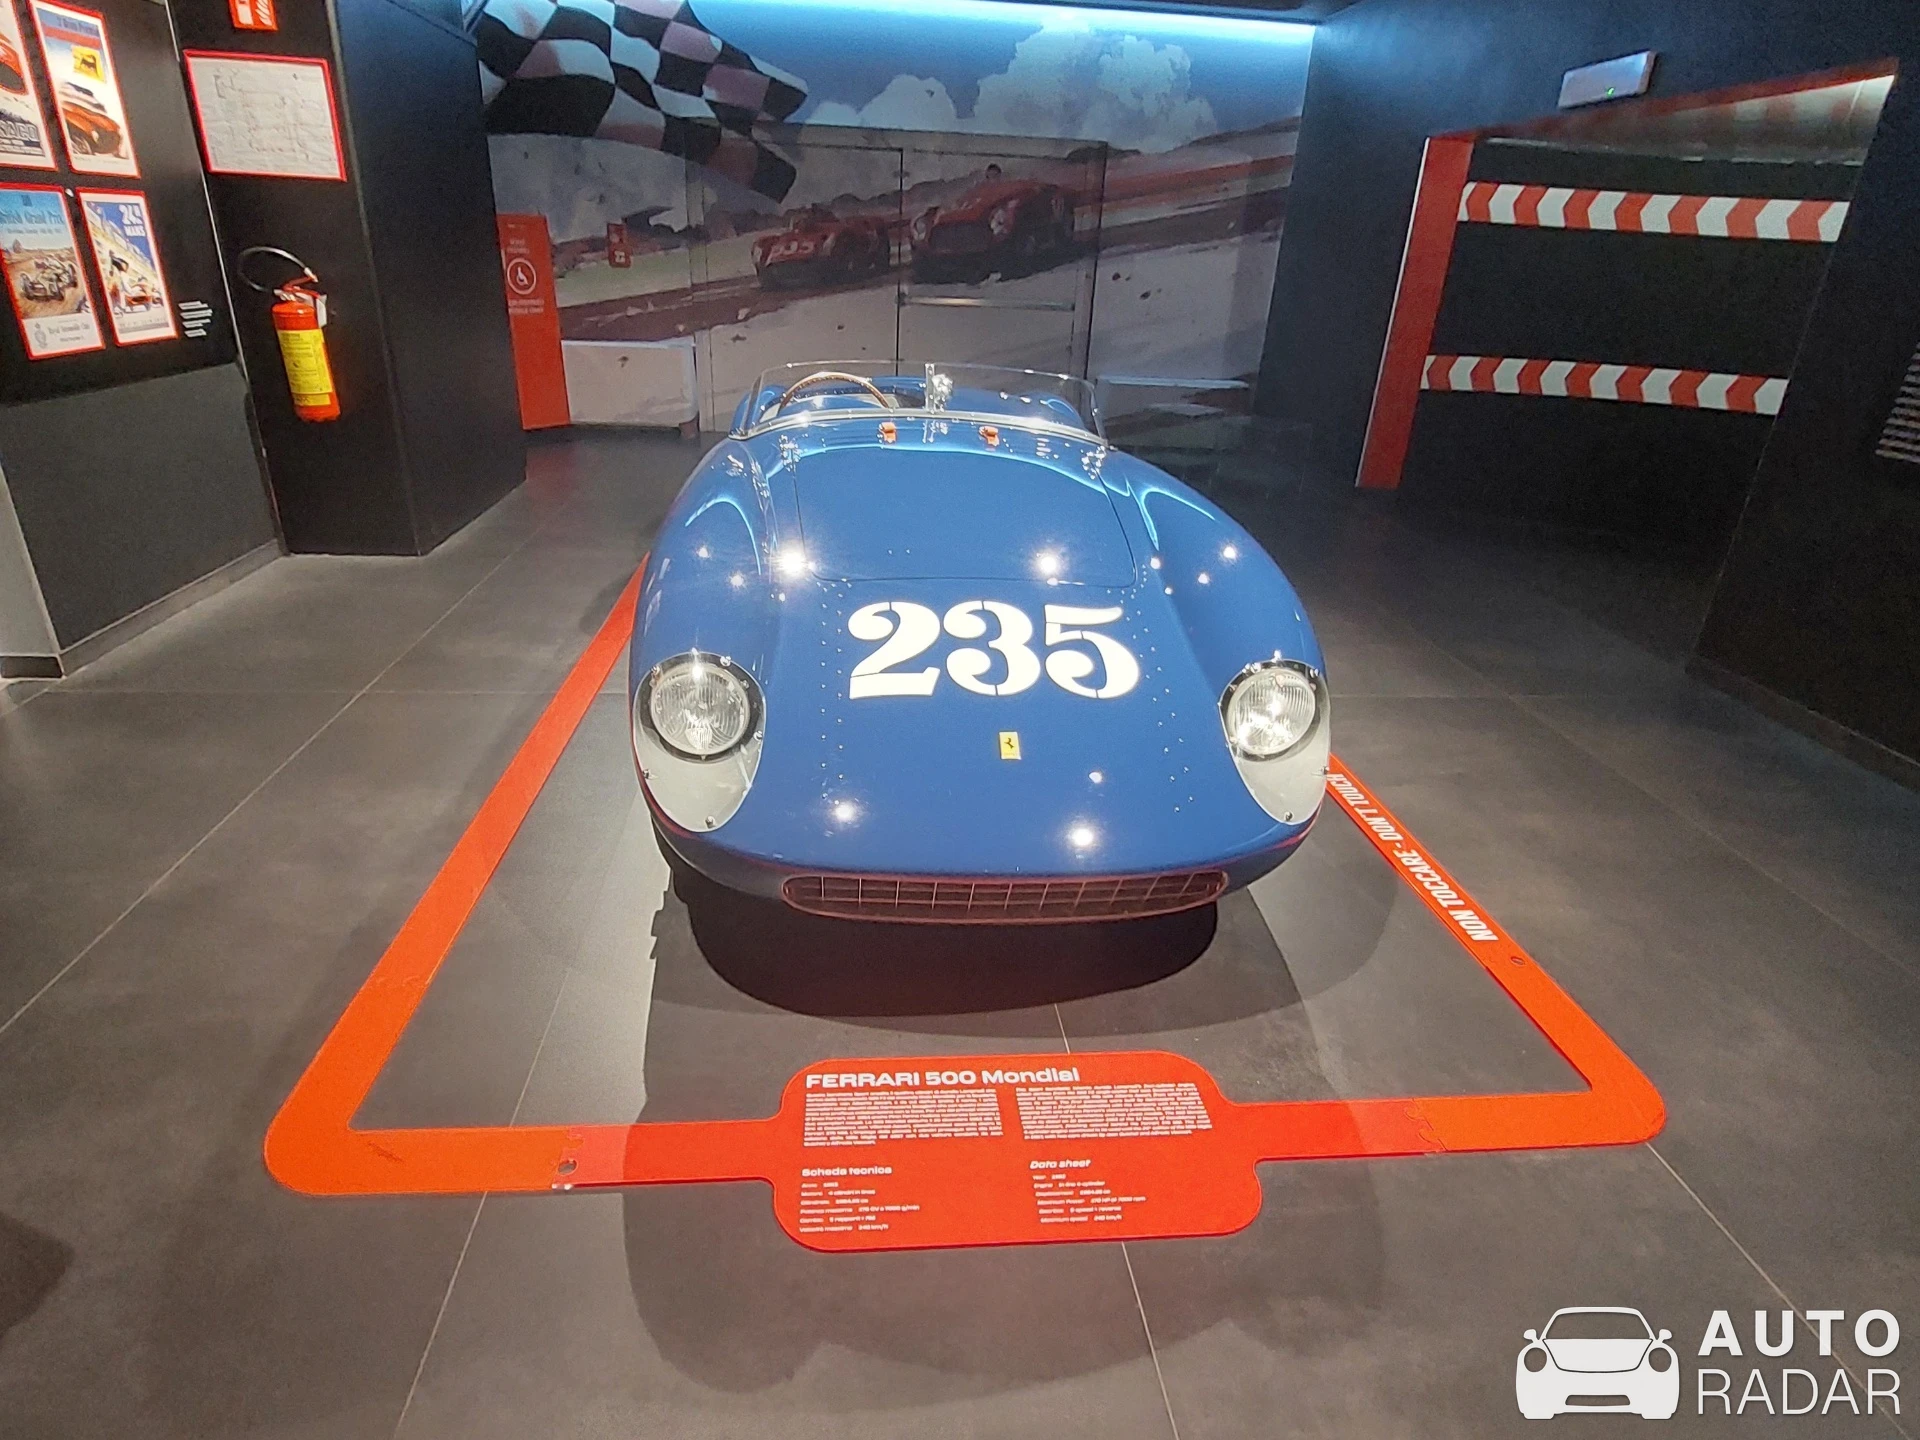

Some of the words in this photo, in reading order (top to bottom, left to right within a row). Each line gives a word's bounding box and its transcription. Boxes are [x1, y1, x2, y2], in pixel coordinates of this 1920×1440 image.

[848, 600, 1139, 699] 235
[1327, 773, 1369, 807] TOUCH
[1393, 849, 1465, 908] TOCCARE
[1448, 909, 1499, 941] NON
[806, 1071, 920, 1088] FERRARI
[925, 1070, 976, 1085] 500
[981, 1067, 1080, 1084] Mondial
[802, 1167, 847, 1177] Scheda
[849, 1165, 892, 1175] tecnica
[1030, 1160, 1057, 1169] Data
[1059, 1159, 1091, 1168] sheet
